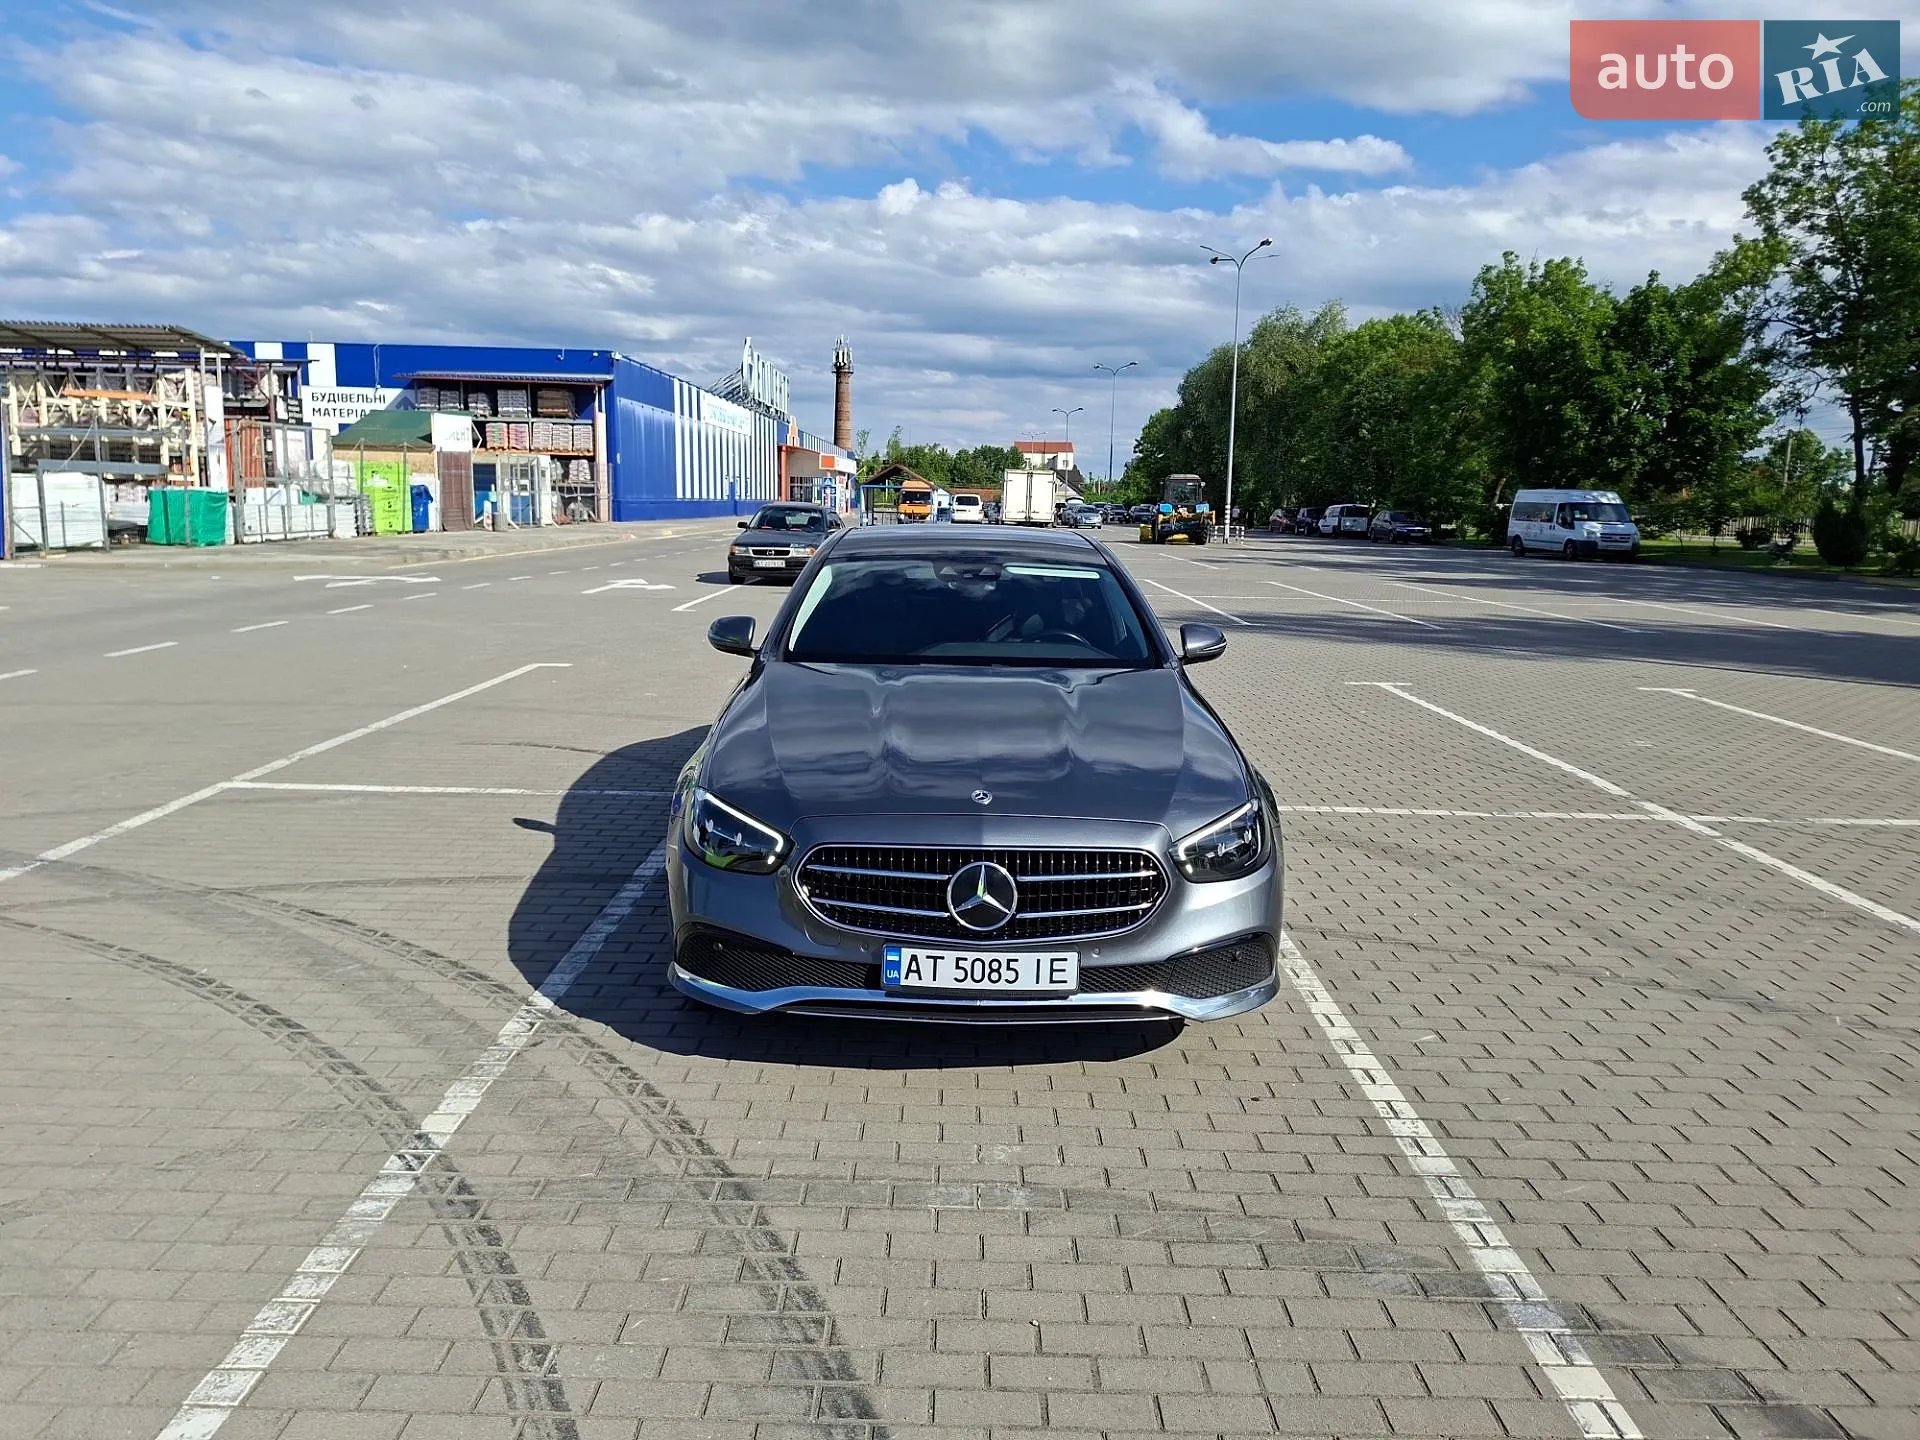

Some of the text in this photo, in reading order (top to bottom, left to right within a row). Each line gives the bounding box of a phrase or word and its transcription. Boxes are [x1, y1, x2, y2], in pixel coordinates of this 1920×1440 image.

[311, 391, 386, 404] БУДІВЕЛЬНІ
[887, 969, 900, 978] UA
[904, 954, 1068, 985] AT 5085 IE
